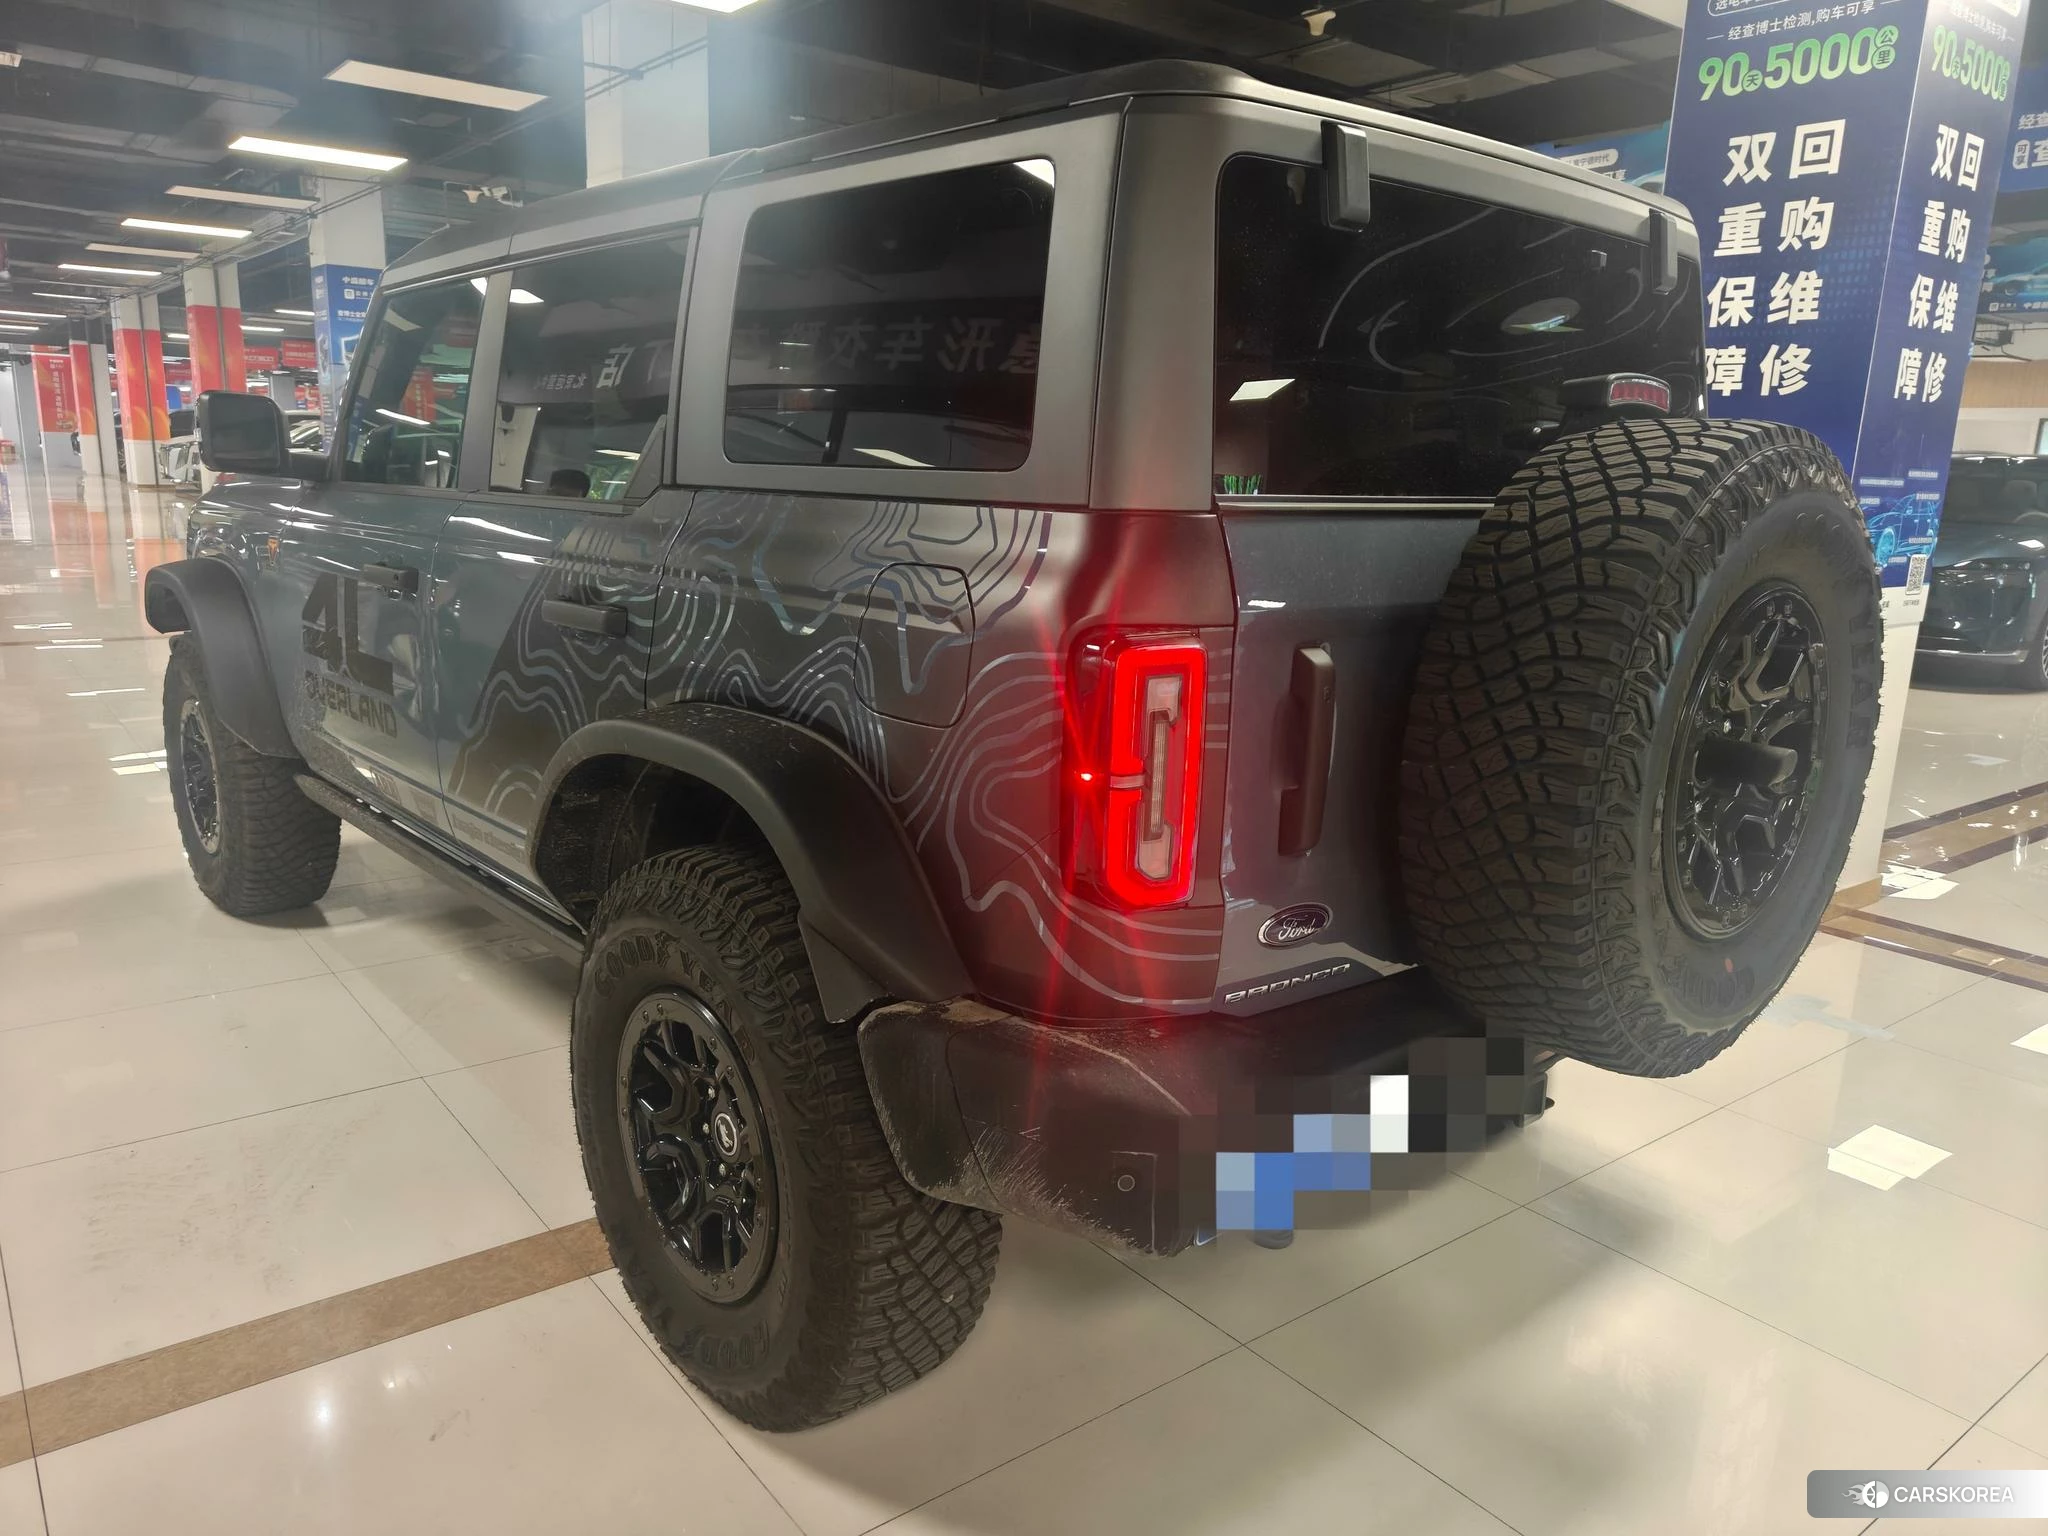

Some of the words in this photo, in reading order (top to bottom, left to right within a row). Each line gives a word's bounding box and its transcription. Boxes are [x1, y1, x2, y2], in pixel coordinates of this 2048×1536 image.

[305, 669, 398, 739] OVERLAND
[1278, 916, 1317, 941] Ford
[1224, 963, 1350, 1005] BRONCO
